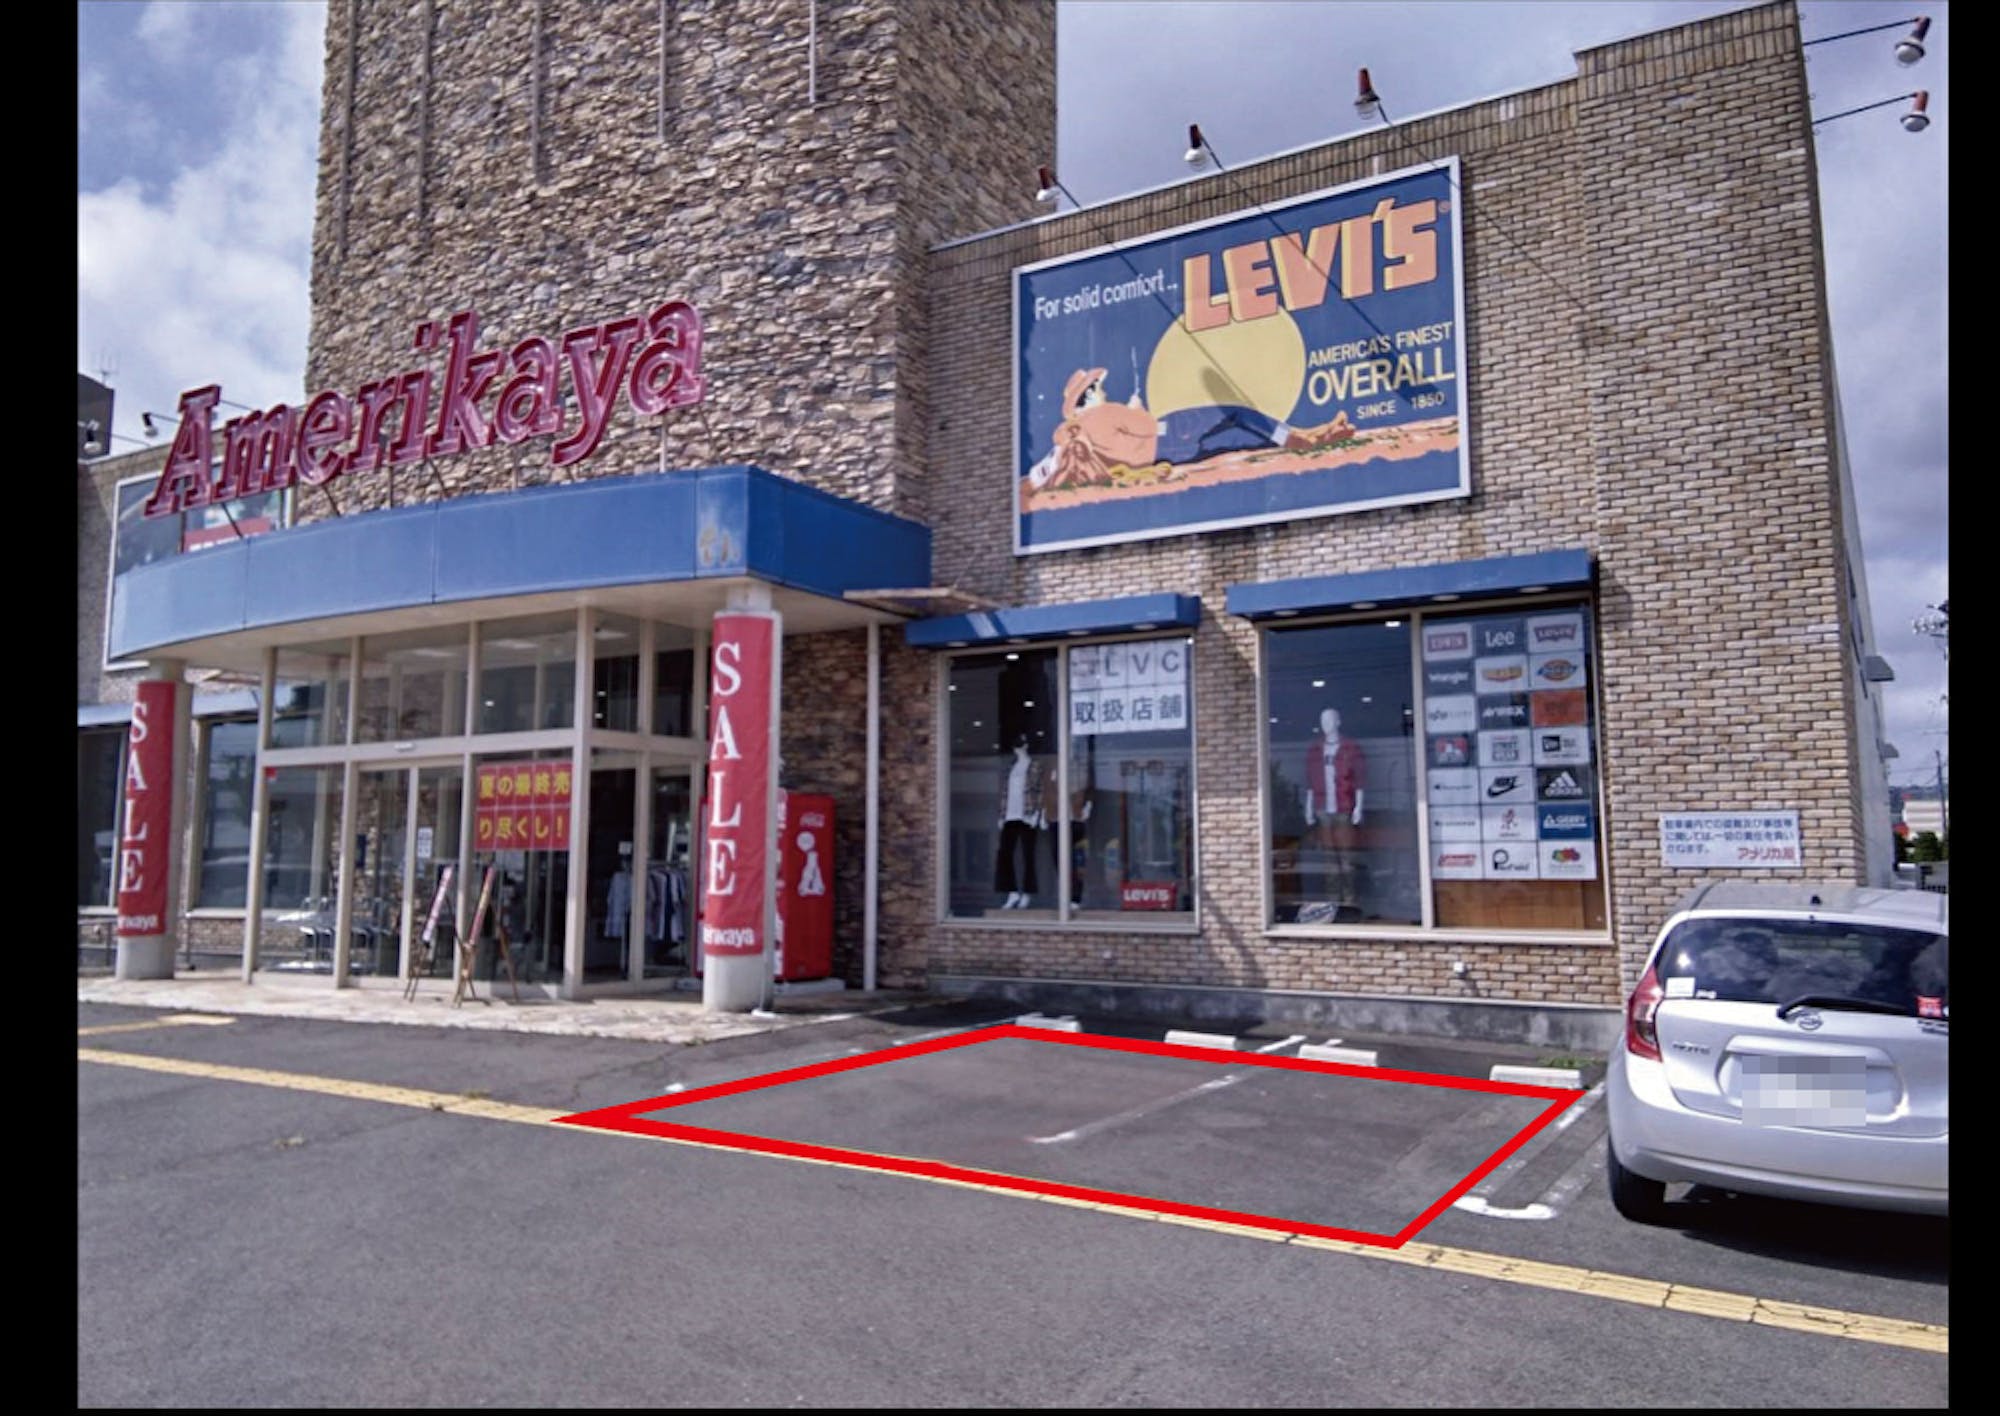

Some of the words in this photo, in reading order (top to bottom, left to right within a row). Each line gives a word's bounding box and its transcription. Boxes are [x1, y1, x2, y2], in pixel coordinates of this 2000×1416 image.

[1184, 198, 1438, 332] LEVI'S
[1035, 297, 1060, 321] For
[1063, 284, 1100, 314] solid
[1308, 334, 1391, 368] AMERICA'S
[1395, 321, 1453, 349] FINEST
[1307, 347, 1455, 405] OVERALL
[145, 299, 706, 516] Amerikaya
[1357, 400, 1396, 420] SINCE
[1484, 630, 1515, 648] Lee
[1075, 694, 1182, 723] 取扱店舗
[480, 772, 570, 799] 夏の最終売
[706, 642, 741, 895] SALE
[119, 701, 147, 893] SALE
